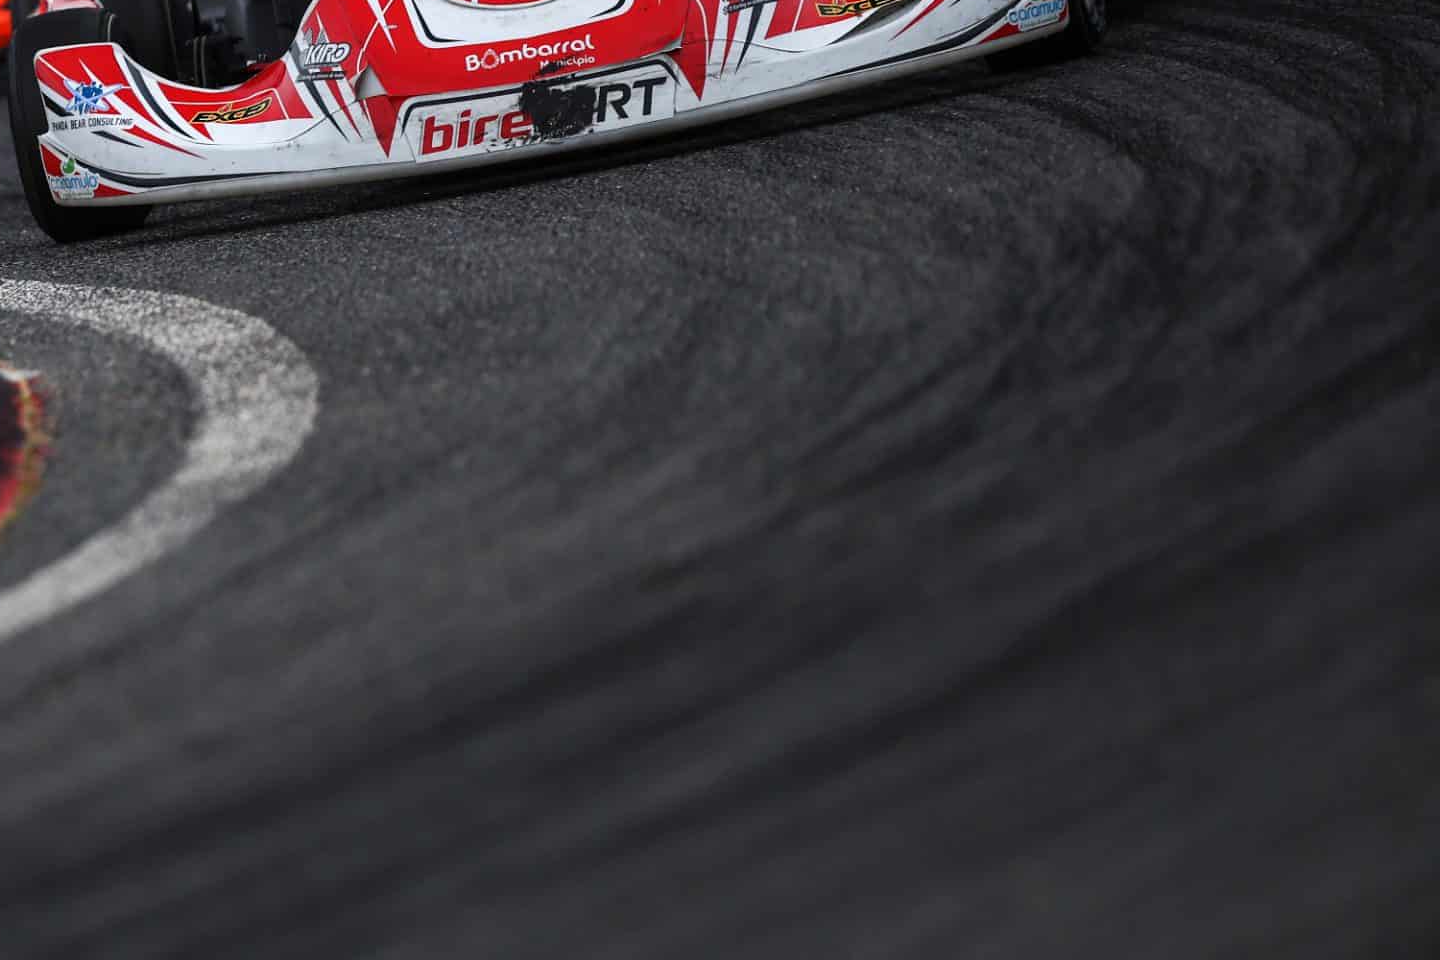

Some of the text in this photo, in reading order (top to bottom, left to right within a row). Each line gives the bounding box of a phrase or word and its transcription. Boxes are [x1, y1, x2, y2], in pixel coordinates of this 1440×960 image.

[305, 43, 351, 65] KIRO
[465, 33, 595, 73] Bombarral
[421, 76, 669, 156] bireRT
